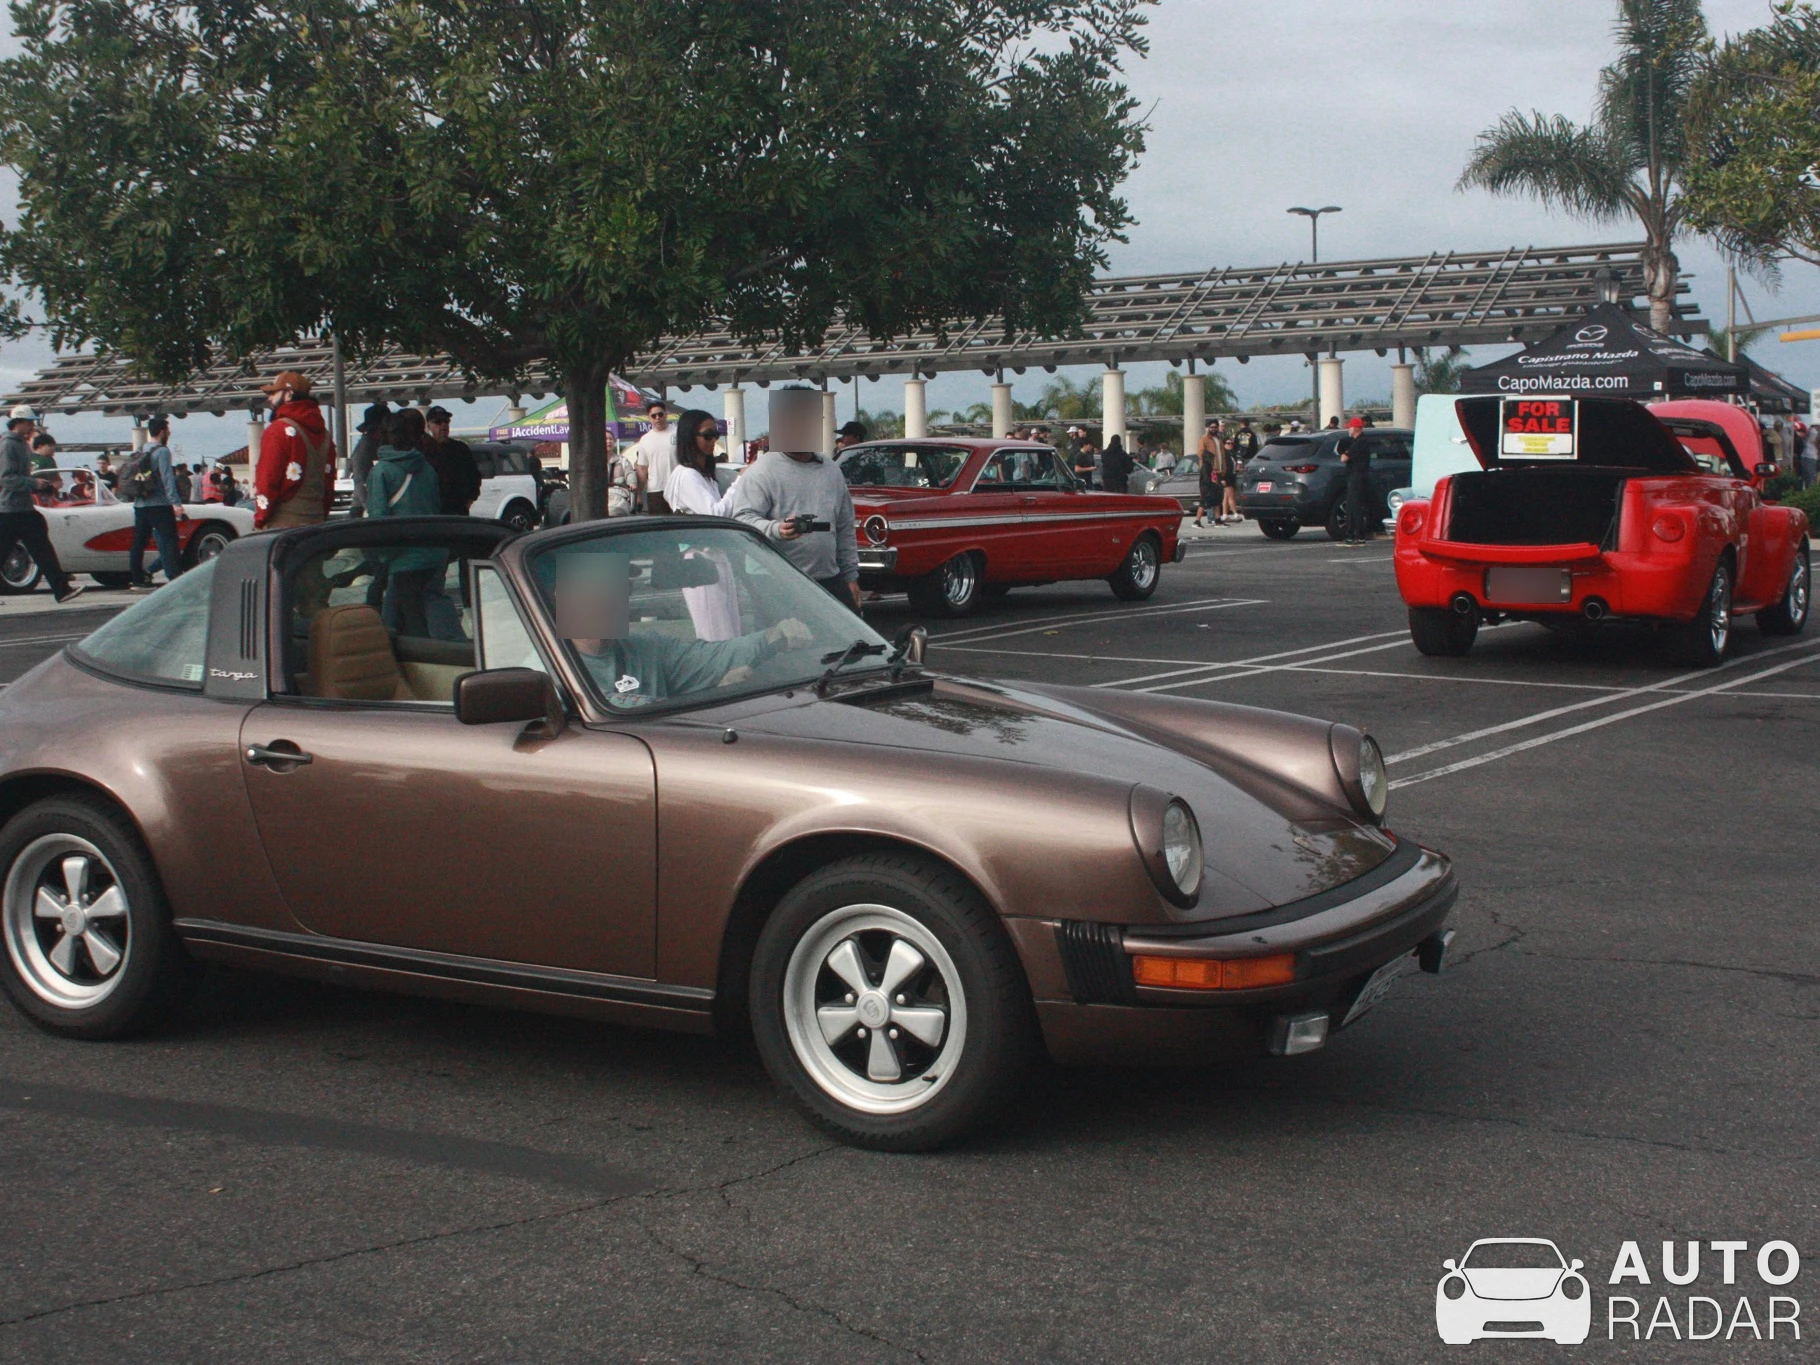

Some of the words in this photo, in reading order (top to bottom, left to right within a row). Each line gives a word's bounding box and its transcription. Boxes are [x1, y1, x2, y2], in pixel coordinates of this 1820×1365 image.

[1517, 351, 1590, 365] Capistrano
[1592, 349, 1639, 359] Mazda
[1498, 374, 1629, 393] CapoMazda.com
[1518, 401, 1560, 417] FOR
[1508, 417, 1570, 433] SALE
[210, 668, 259, 681] targa
